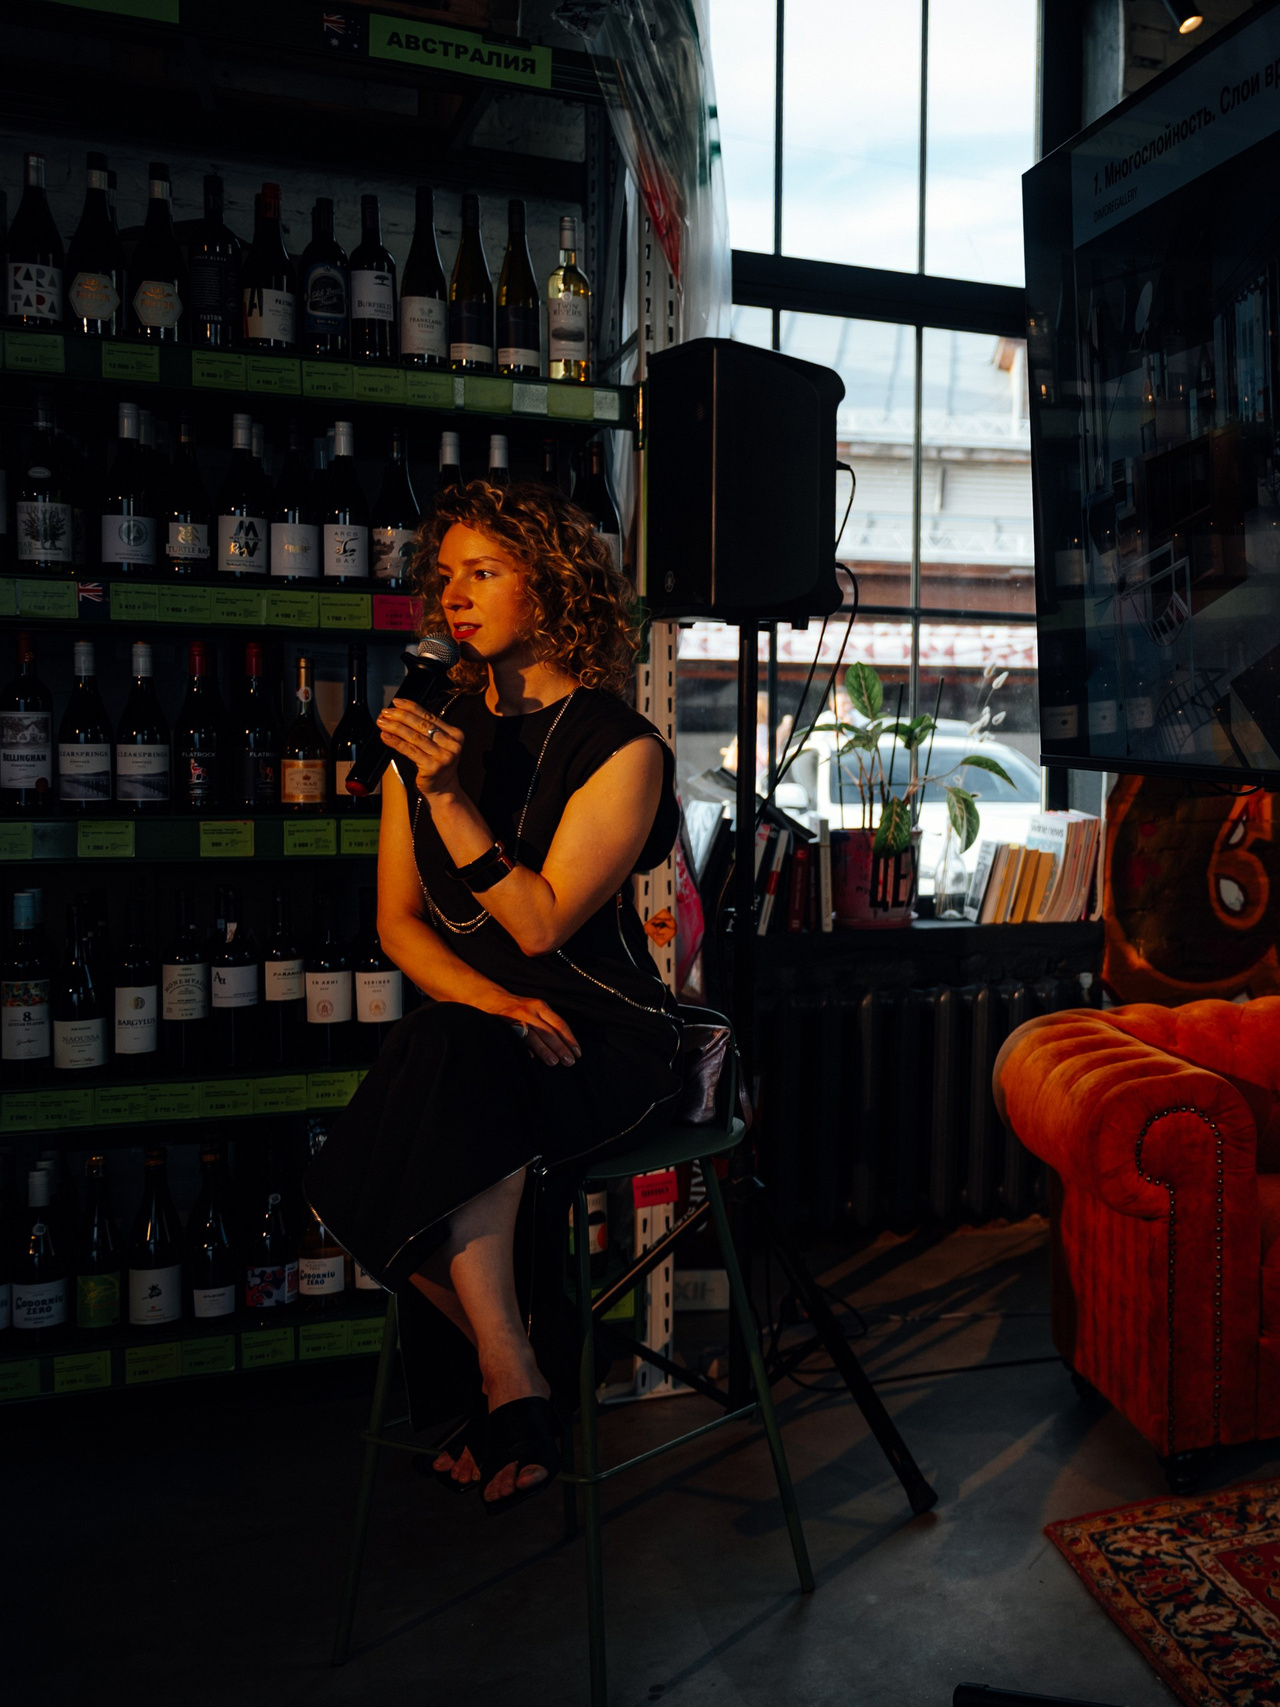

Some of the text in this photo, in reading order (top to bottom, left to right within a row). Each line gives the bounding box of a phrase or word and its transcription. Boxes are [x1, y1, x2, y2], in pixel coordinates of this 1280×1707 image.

[386, 31, 537, 75] АВСТРАЛИЯ
[1093, 171, 1102, 196] 1.
[1104, 105, 1216, 189] Многослойность.
[1220, 71, 1261, 115] Слои
[557, 302, 578, 311] TWIN
[167, 545, 210, 554] TURTLE BAY
[336, 557, 357, 565] BAY
[2, 752, 47, 762] BELLINGHAM
[23, 1011, 32, 1022] 8
[117, 1018, 156, 1027] BARGYLUS
[62, 1034, 100, 1044] NAOUSSA
[26, 1305, 52, 1315] ZERO
